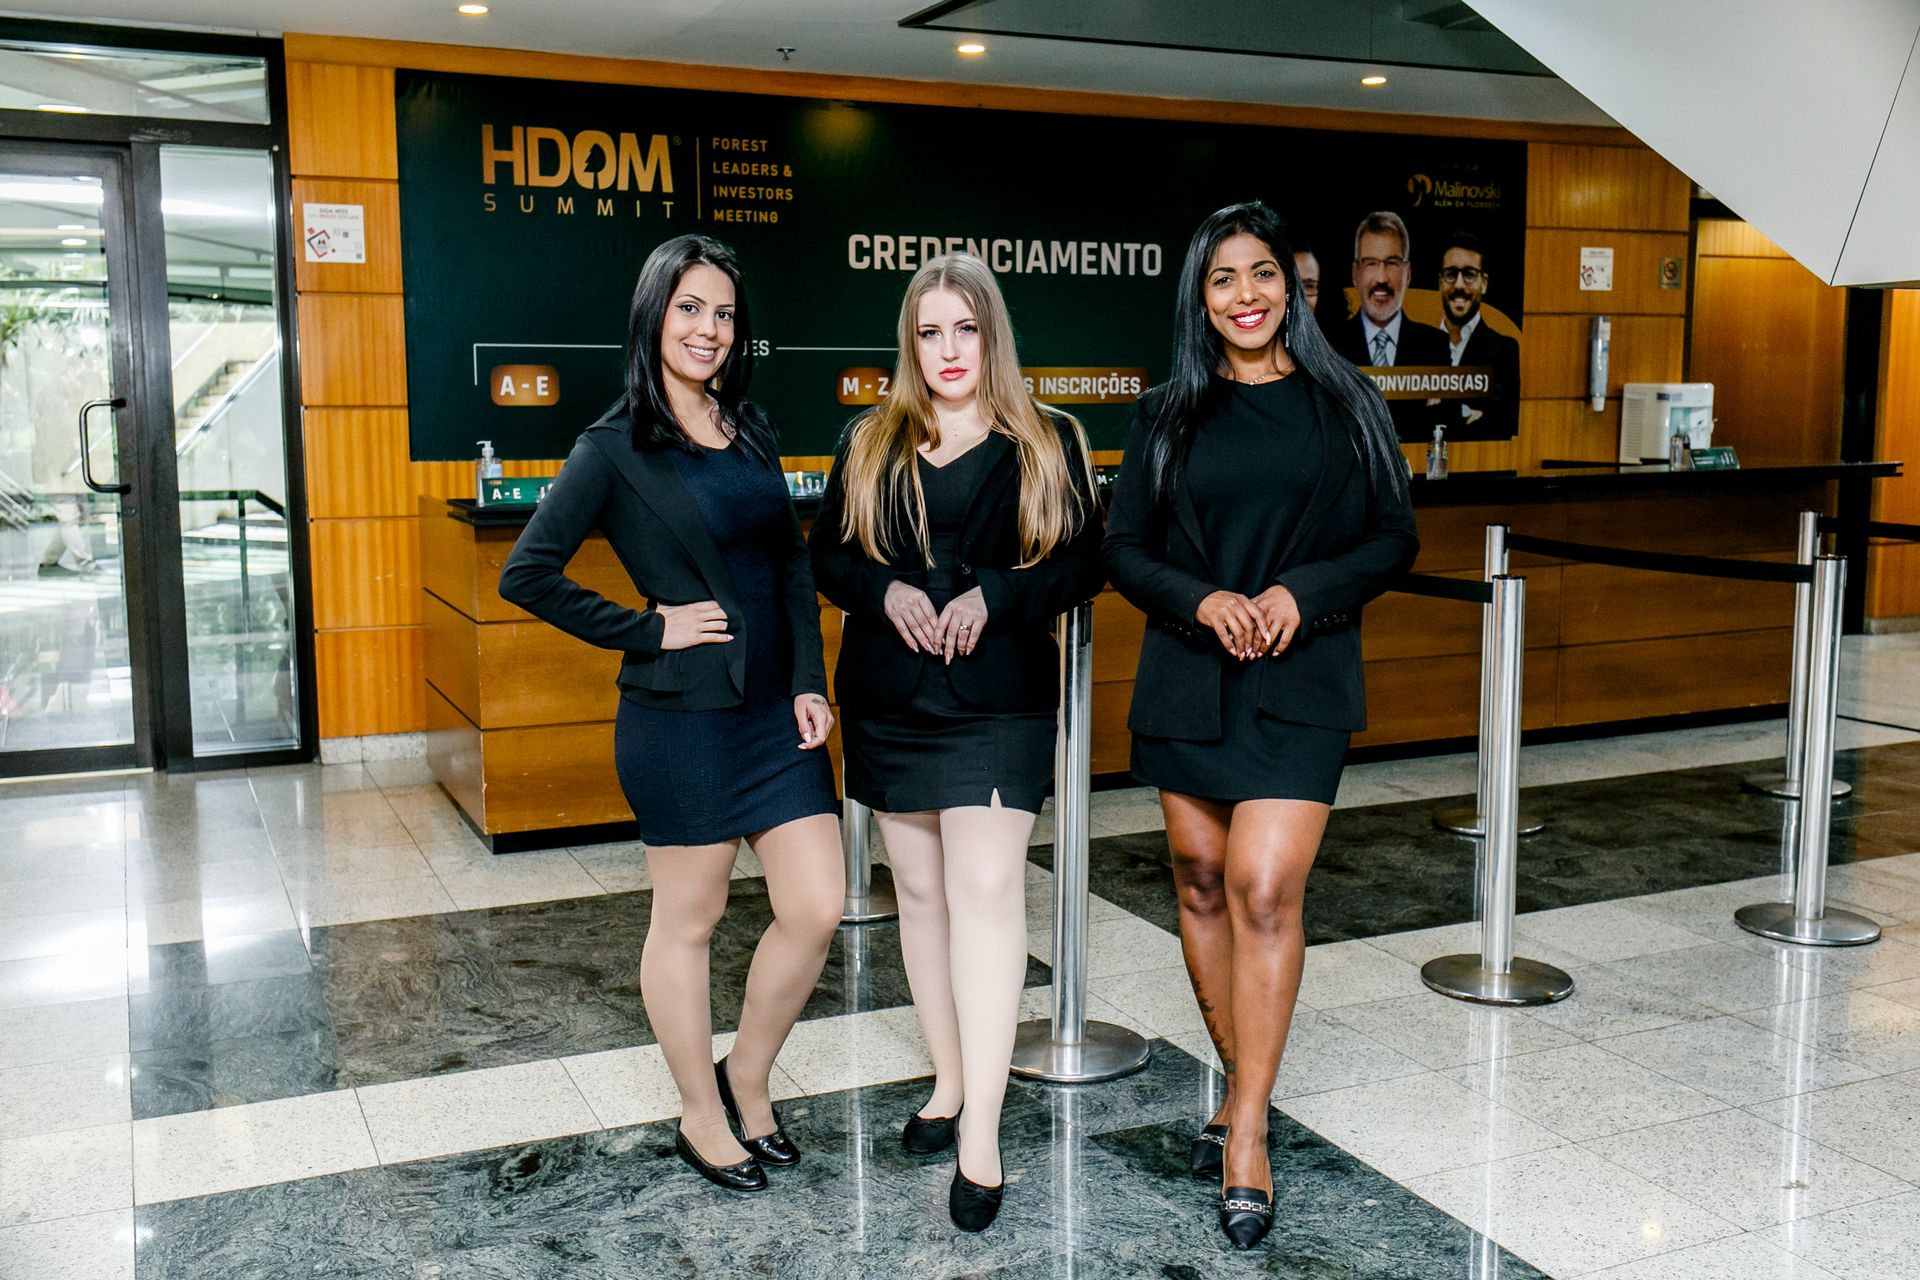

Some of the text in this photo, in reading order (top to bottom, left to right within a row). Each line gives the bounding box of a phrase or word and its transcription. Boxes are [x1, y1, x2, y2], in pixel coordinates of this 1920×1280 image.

[712, 137, 767, 152] FOREST
[482, 124, 674, 193] HDOM
[712, 162, 792, 177] LEADERS &
[713, 186, 793, 201] INVESTORS
[484, 192, 674, 219] SUMMIT
[714, 210, 778, 223] MEETING
[1040, 372, 1141, 399] INSCRIÇÕES
[1369, 374, 1489, 393] ONVIDADOS(AS)
